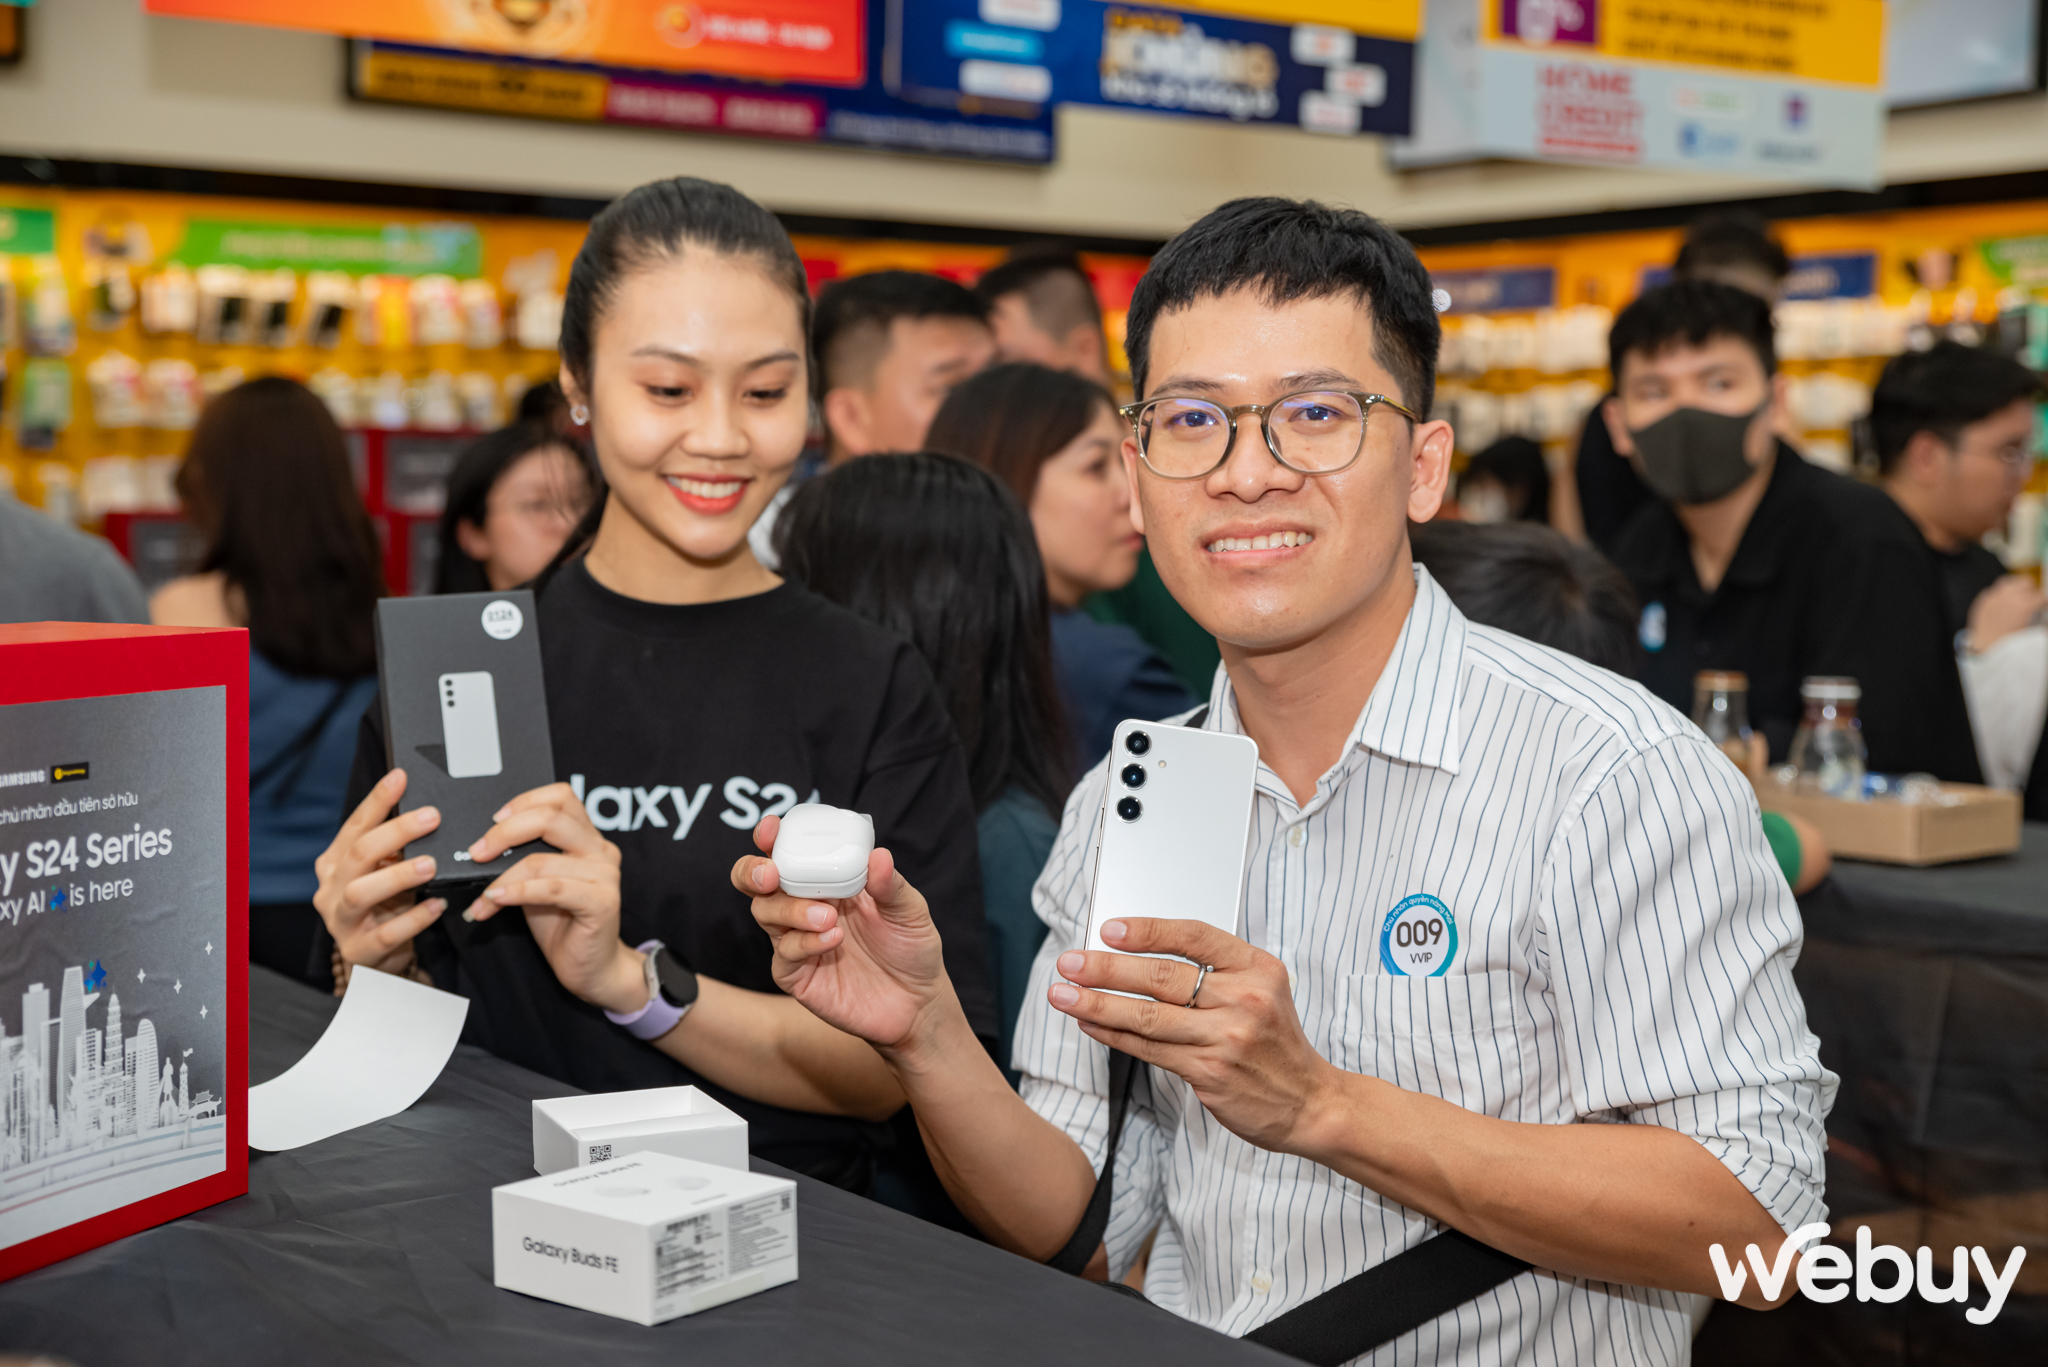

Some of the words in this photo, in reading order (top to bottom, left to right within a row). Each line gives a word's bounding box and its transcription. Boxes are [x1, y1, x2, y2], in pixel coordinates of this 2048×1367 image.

[118, 791, 139, 808] hữu
[719, 775, 821, 830] S2
[26, 835, 79, 879] S24
[86, 822, 173, 868] Series
[27, 890, 46, 916] AI
[69, 882, 85, 907] is
[89, 877, 134, 904] here
[1392, 902, 1409, 918] nhân
[1408, 895, 1429, 905] quyền
[1396, 918, 1443, 947] 009
[1410, 952, 1432, 963] VVIP
[522, 1236, 569, 1265] Galaxy
[571, 1247, 602, 1269] Buds
[605, 1255, 619, 1274] FE
